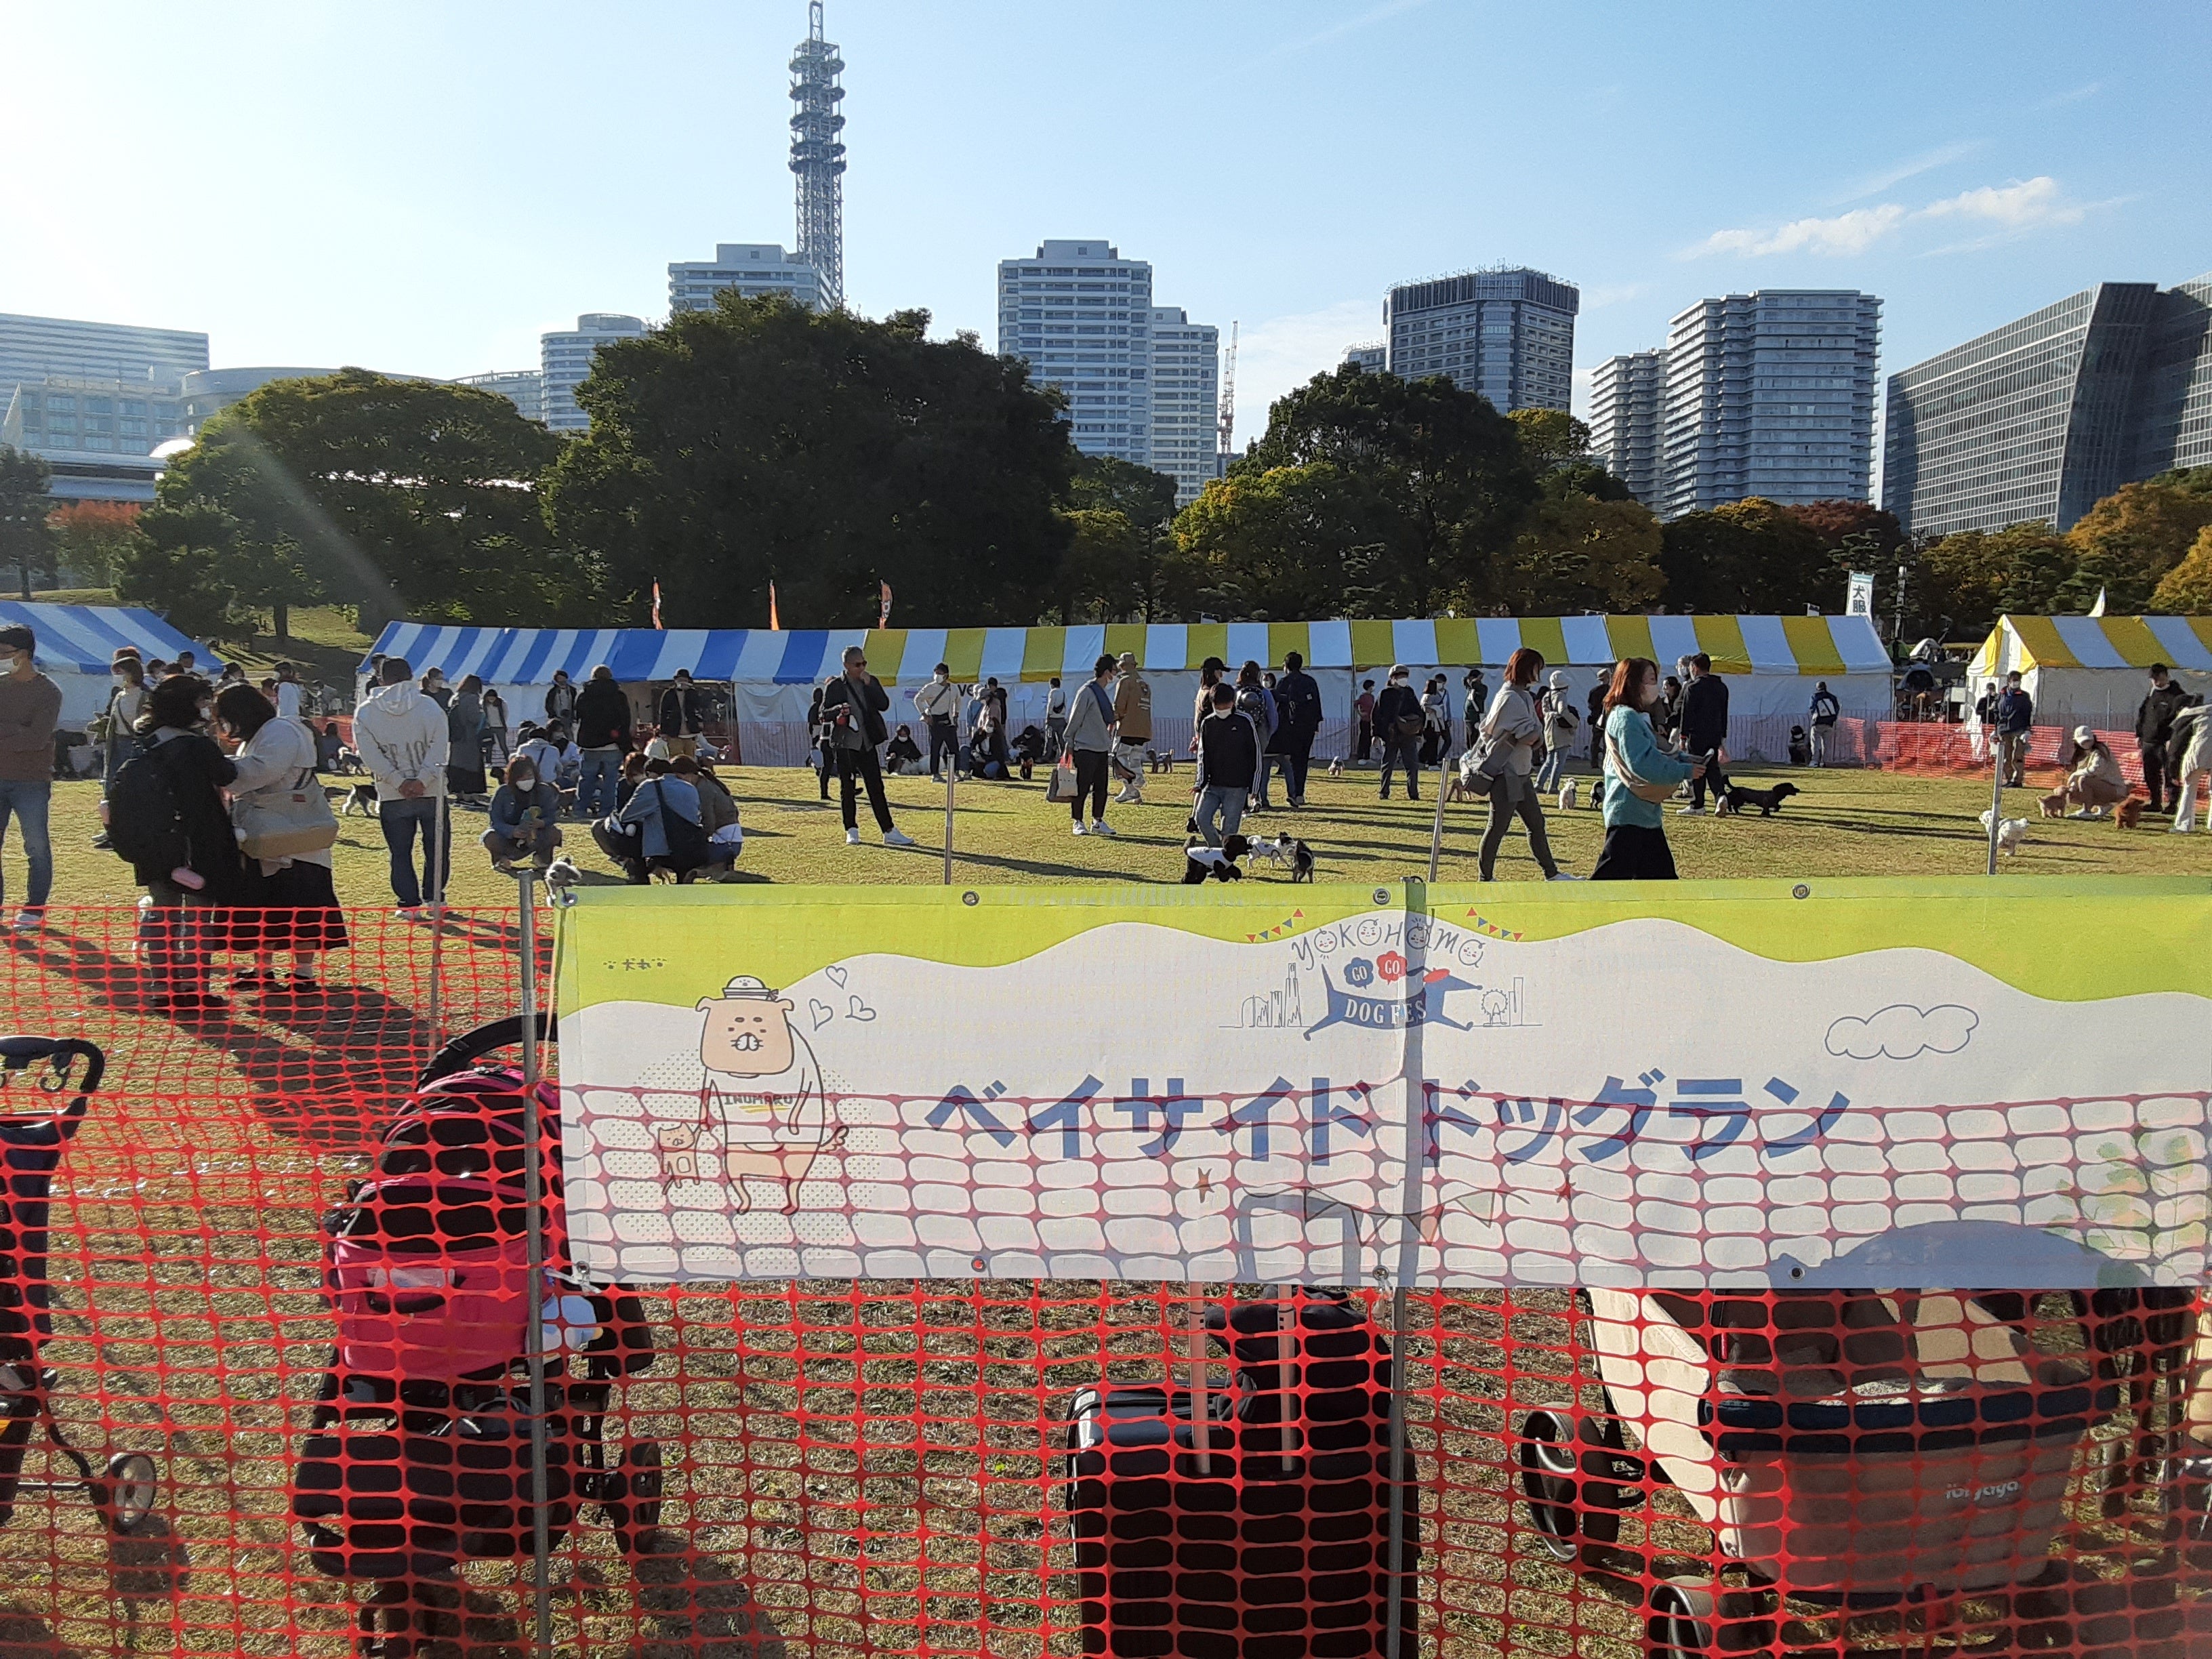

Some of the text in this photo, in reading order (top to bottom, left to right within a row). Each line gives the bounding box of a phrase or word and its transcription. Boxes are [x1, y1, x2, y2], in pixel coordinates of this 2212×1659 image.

[1853, 585, 1866, 615] 犬服
[1352, 960, 1400, 981] GO GO
[1345, 998, 1384, 1023] DOG
